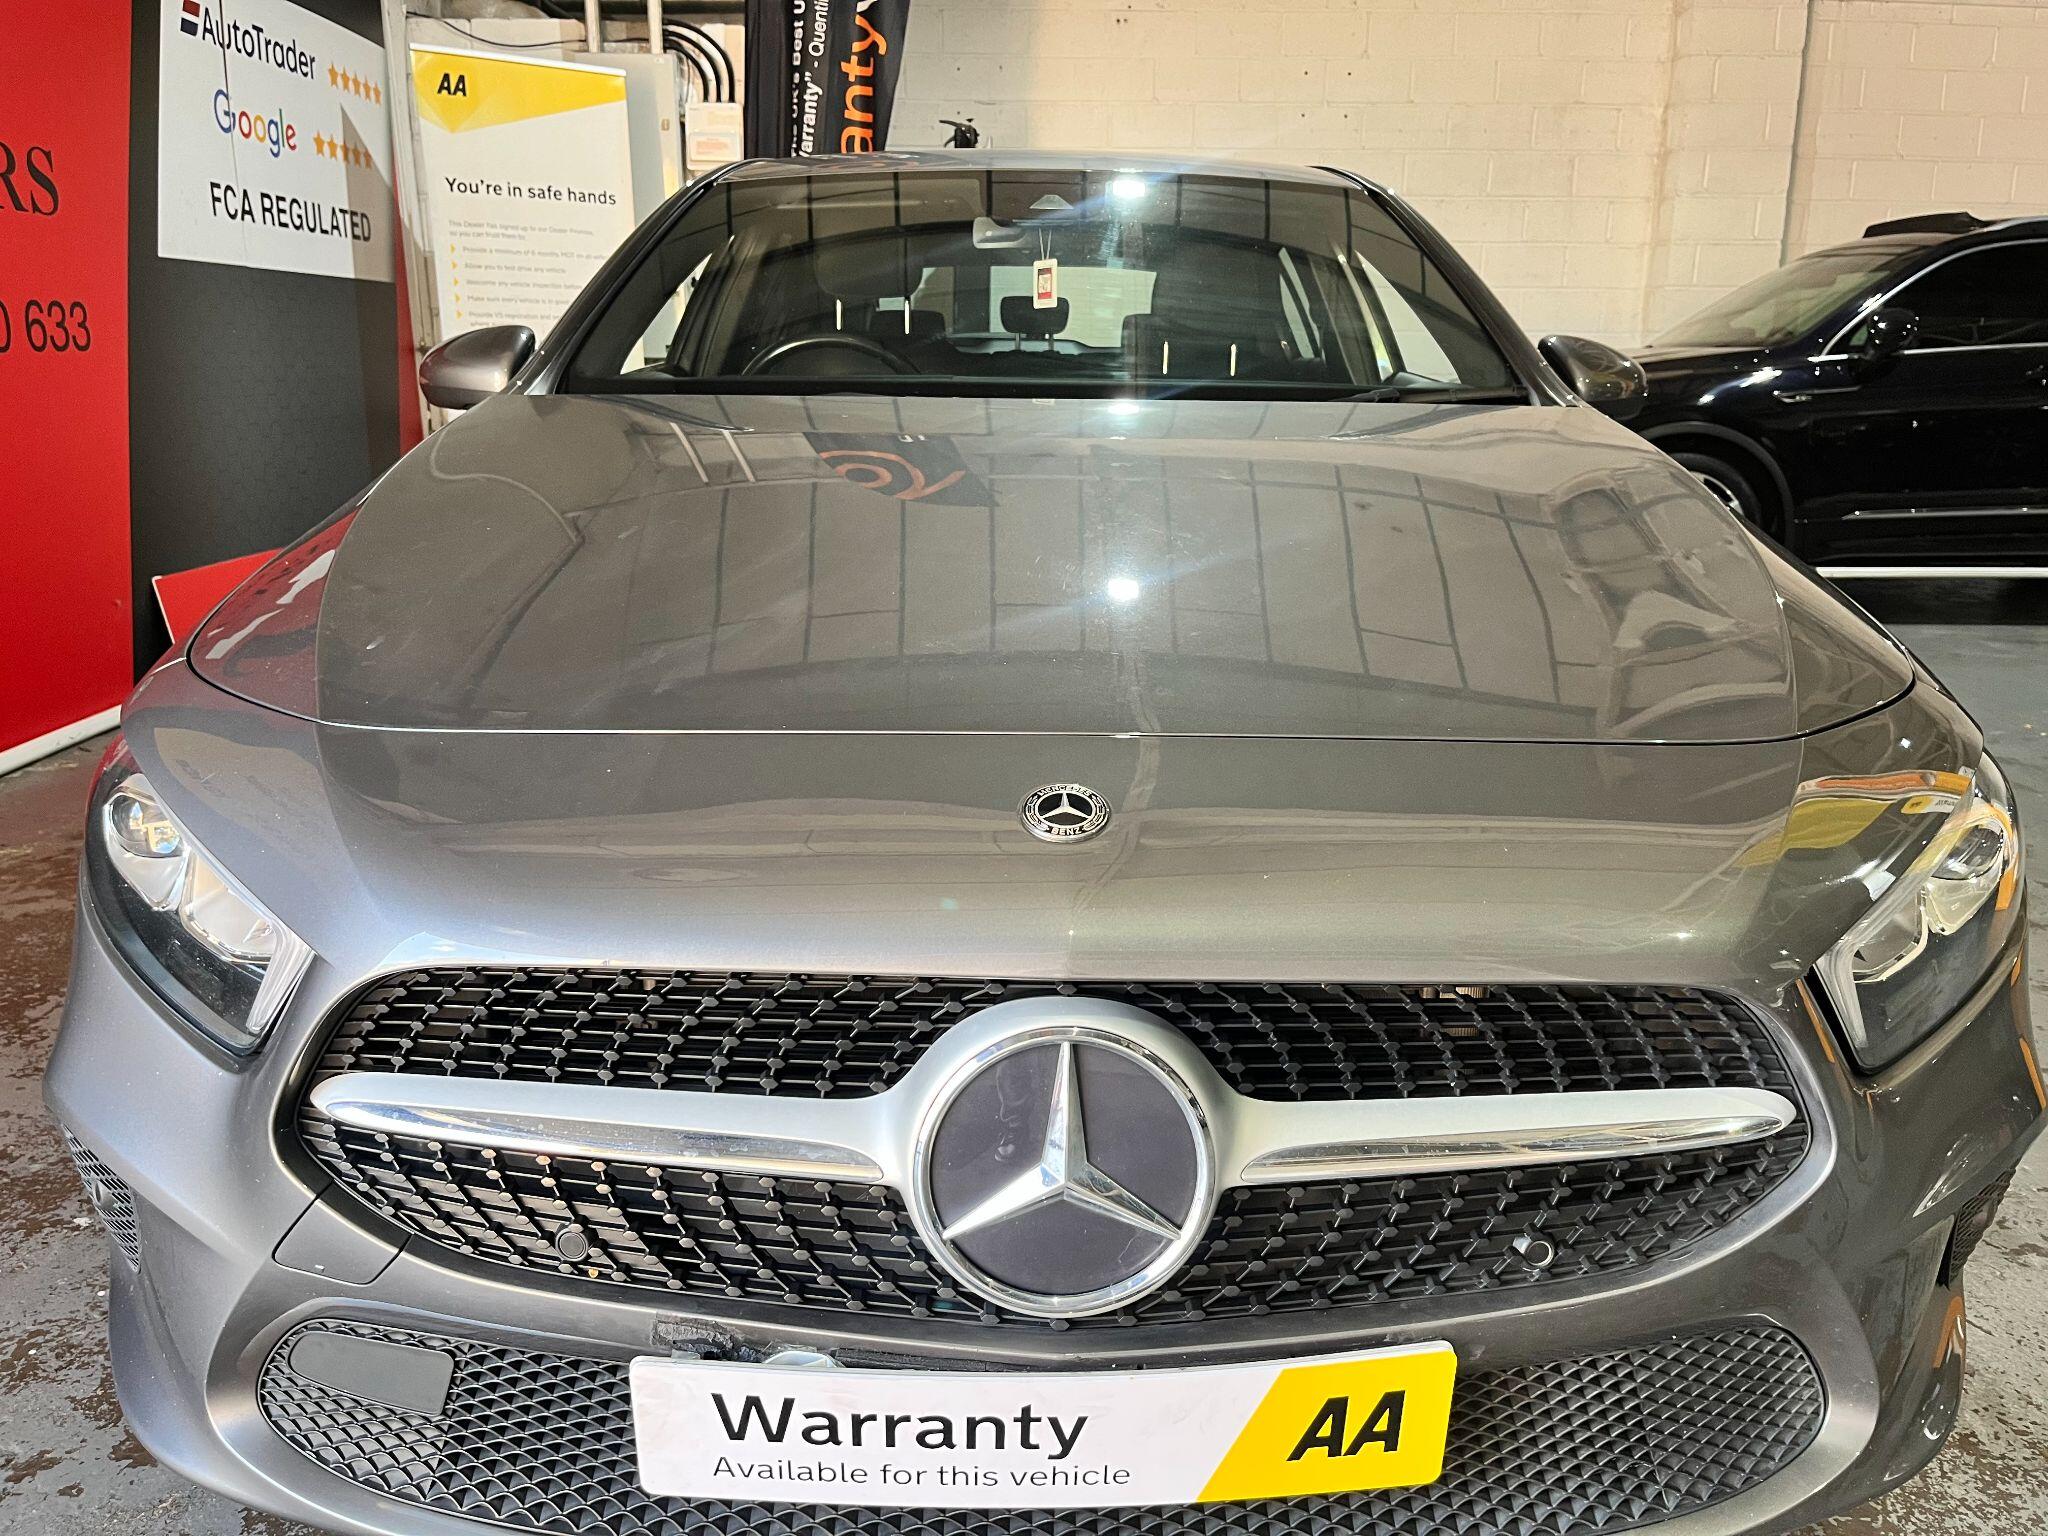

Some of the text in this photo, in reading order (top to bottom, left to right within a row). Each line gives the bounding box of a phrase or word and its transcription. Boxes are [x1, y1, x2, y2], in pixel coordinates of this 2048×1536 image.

[201, 8, 316, 80] AutoTrader
[792, 20, 804, 66] Best
[437, 73, 467, 97] AA
[213, 88, 297, 158] Google
[210, 181, 372, 242] FCA REGULATED
[445, 176, 617, 206] You're in safe hands
[25, 299, 91, 353] 633
[1037, 784, 1093, 797] MERCEDES
[1050, 827, 1083, 836] BENZ
[711, 1392, 1089, 1460] Warranty
[1287, 1389, 1406, 1462] AA
[713, 1456, 1131, 1487] Available for this vehicle
